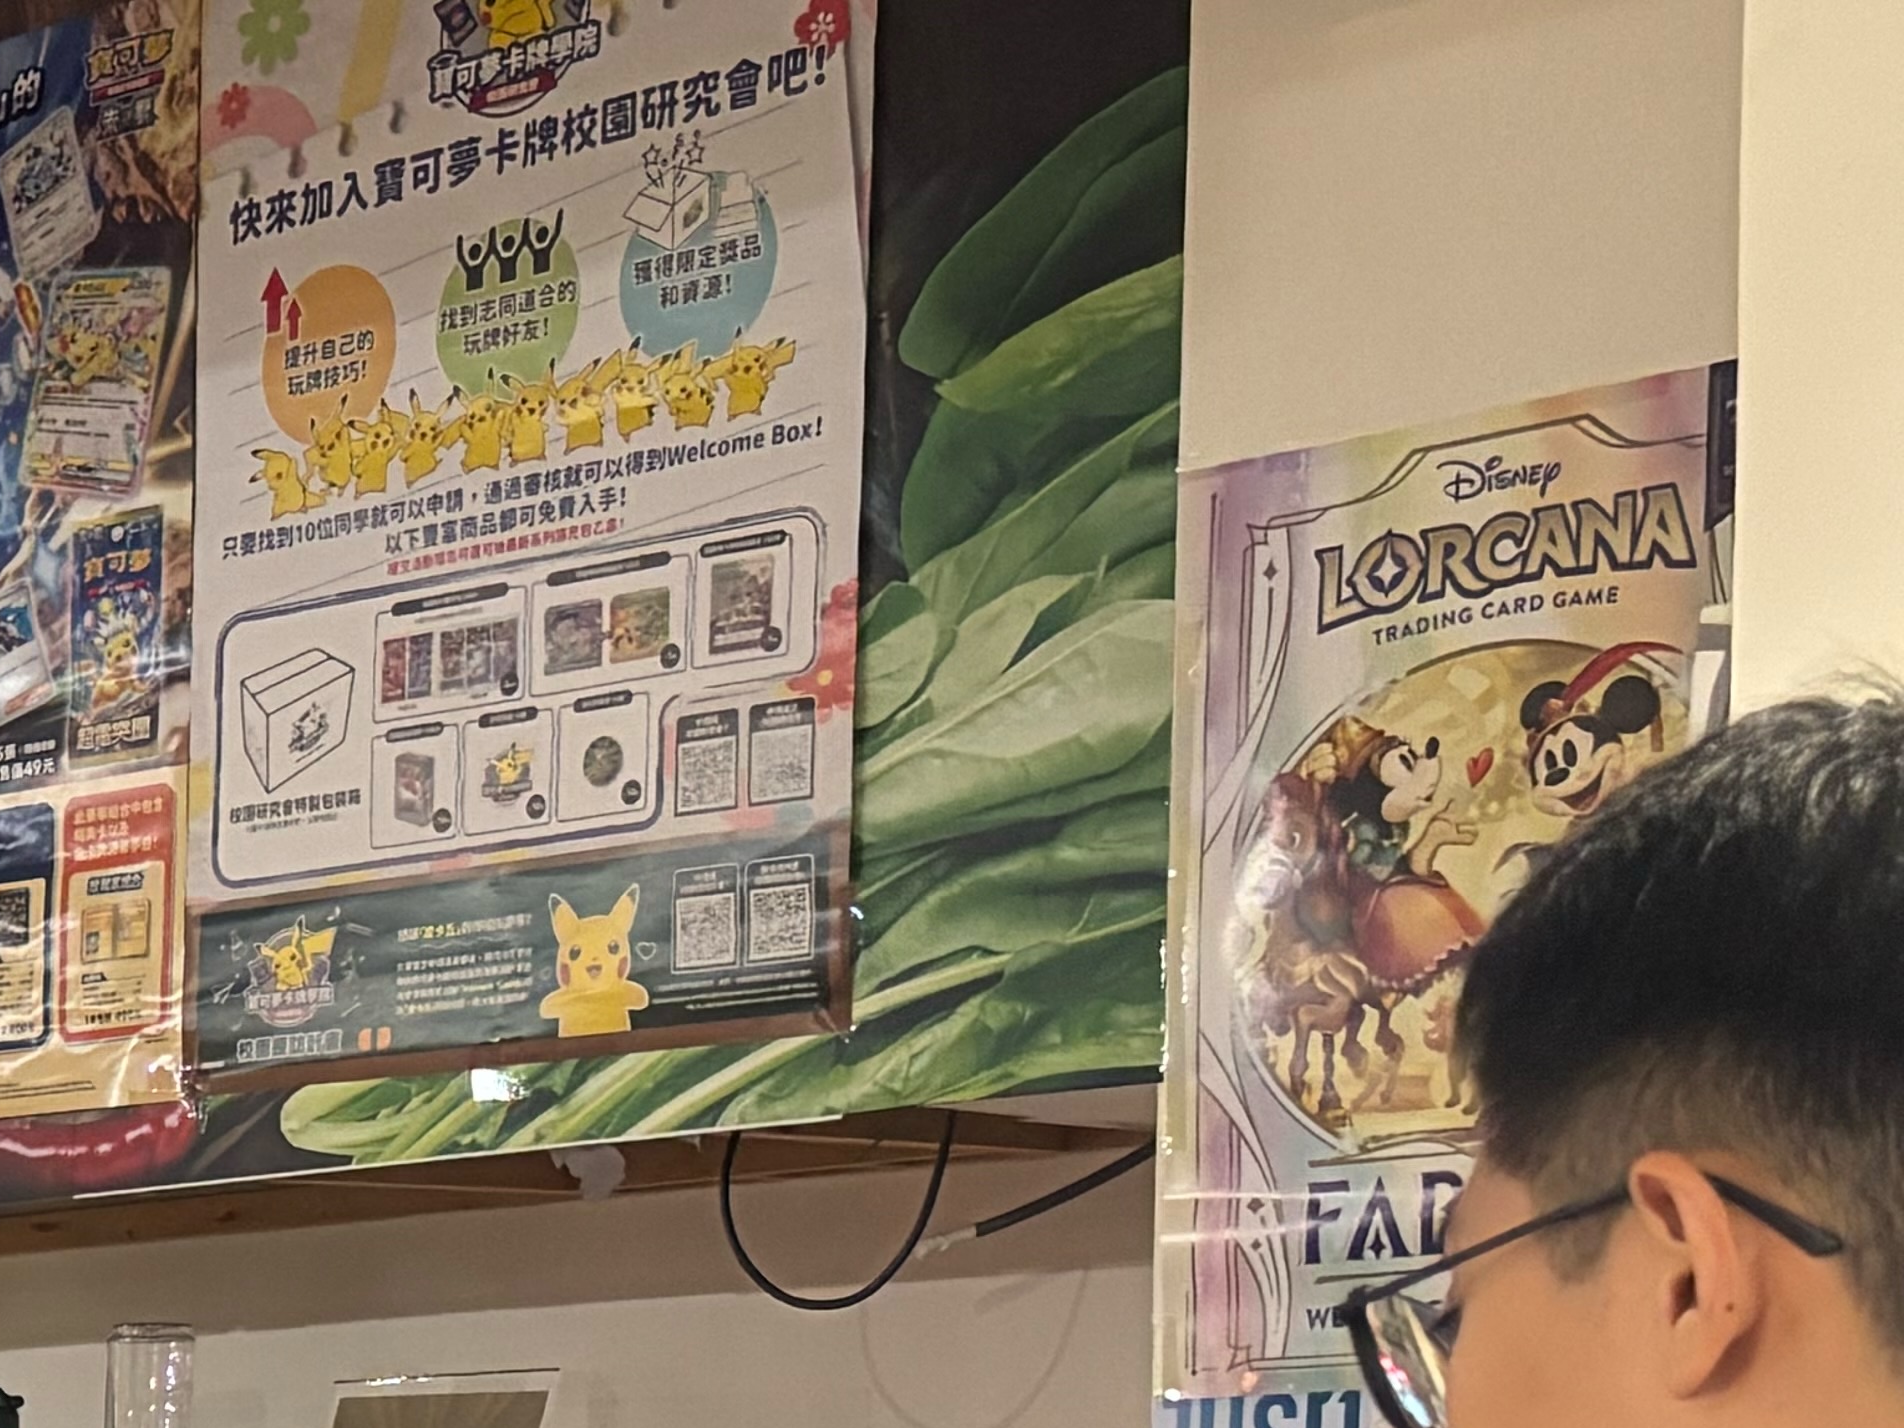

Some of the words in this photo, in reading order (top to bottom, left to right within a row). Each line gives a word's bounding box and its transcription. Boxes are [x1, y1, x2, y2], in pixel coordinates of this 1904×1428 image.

[229, 46, 828, 246] 快來加入寶可夢卡牌校園研究會吧!
[633, 236, 762, 285] 獲得限定獎品
[439, 281, 578, 334] 找到志同道合的
[660, 273, 733, 309] 和資源!
[283, 328, 375, 367] 提升自己的
[463, 318, 551, 354] 玩牌好友!
[287, 361, 368, 396] 玩牌技巧!
[771, 416, 823, 451] Box!
[1315, 482, 1696, 635] LORCANA
[1373, 607, 1473, 646] TRADING
[1482, 594, 1544, 622] CARD
[1553, 585, 1620, 611] GAME
